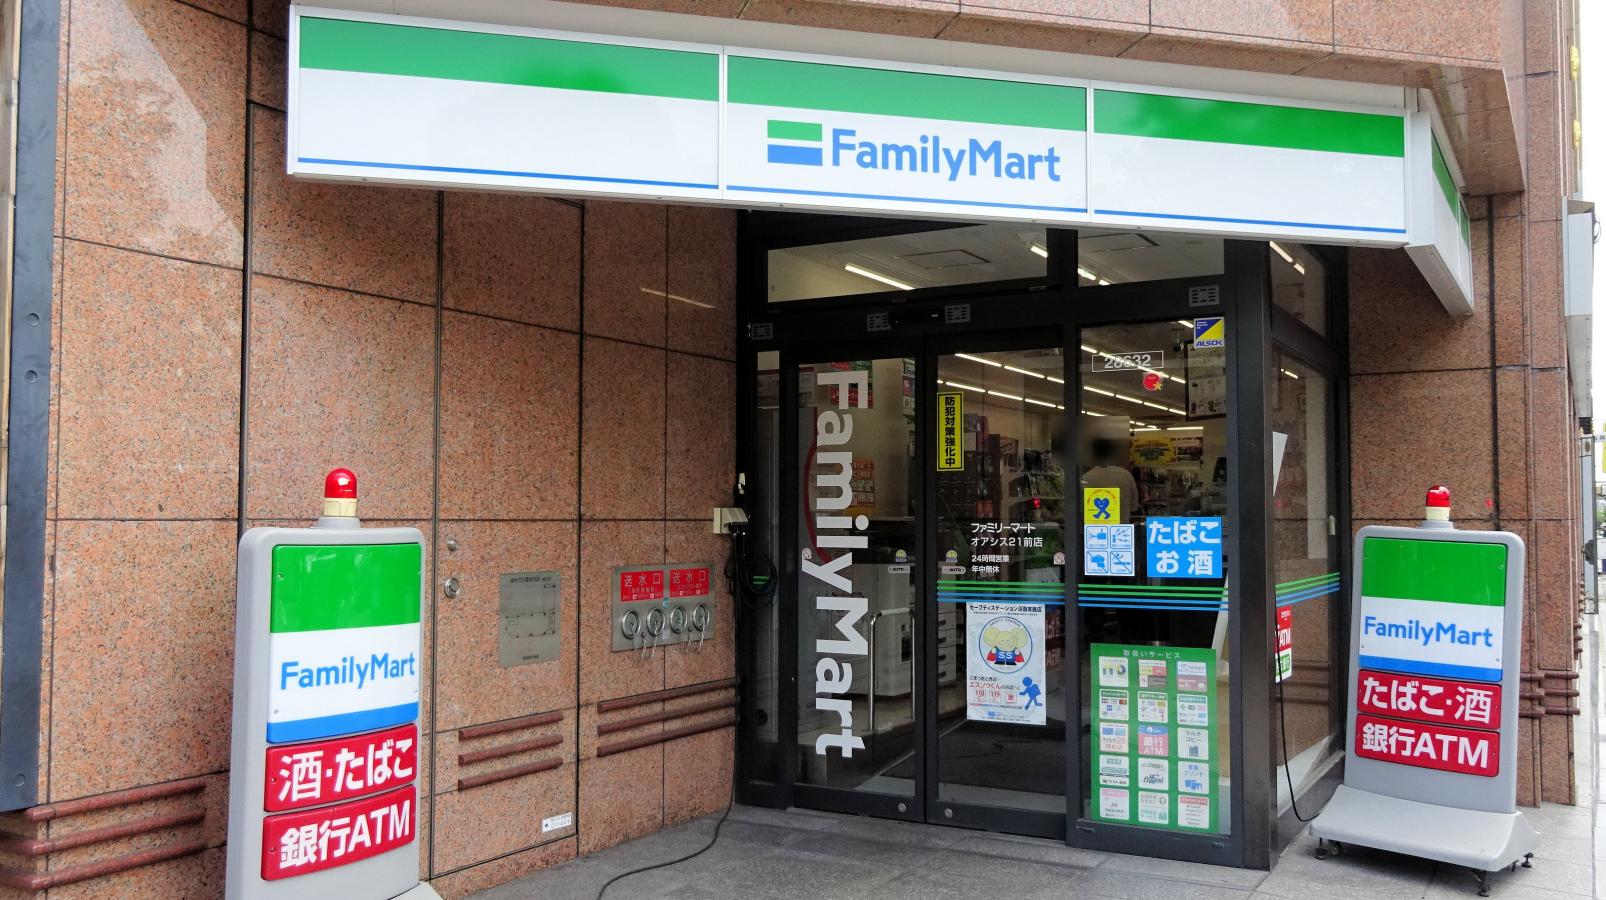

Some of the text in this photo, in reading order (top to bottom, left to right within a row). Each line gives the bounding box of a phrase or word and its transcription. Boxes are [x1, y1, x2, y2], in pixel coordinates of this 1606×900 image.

[832, 128, 1060, 181] FamilyMart
[1104, 354, 1151, 369] 28632
[944, 396, 956, 467] 防犯対策強化中
[971, 522, 1036, 534] ファミリーマート
[1148, 520, 1221, 545] たばこ
[971, 537, 1043, 548] オアシス21前店
[802, 370, 868, 758] FamilyMart
[971, 554, 1010, 563] 24時間営業
[971, 565, 1000, 573] 年中無休
[1155, 550, 1213, 575] お酒
[624, 573, 661, 587] 送水口
[673, 570, 706, 584] 送水口
[1364, 616, 1493, 647] FamilyMart
[998, 651, 1013, 660] SS
[1123, 649, 1181, 659] 取扱いサービス
[280, 652, 415, 690] FamilyMart
[1363, 677, 1493, 723] たばこ・酒
[1362, 723, 1489, 769] 銀行ATM
[279, 738, 412, 802] 酒・たばこ
[279, 800, 410, 869] 銀行ATM
